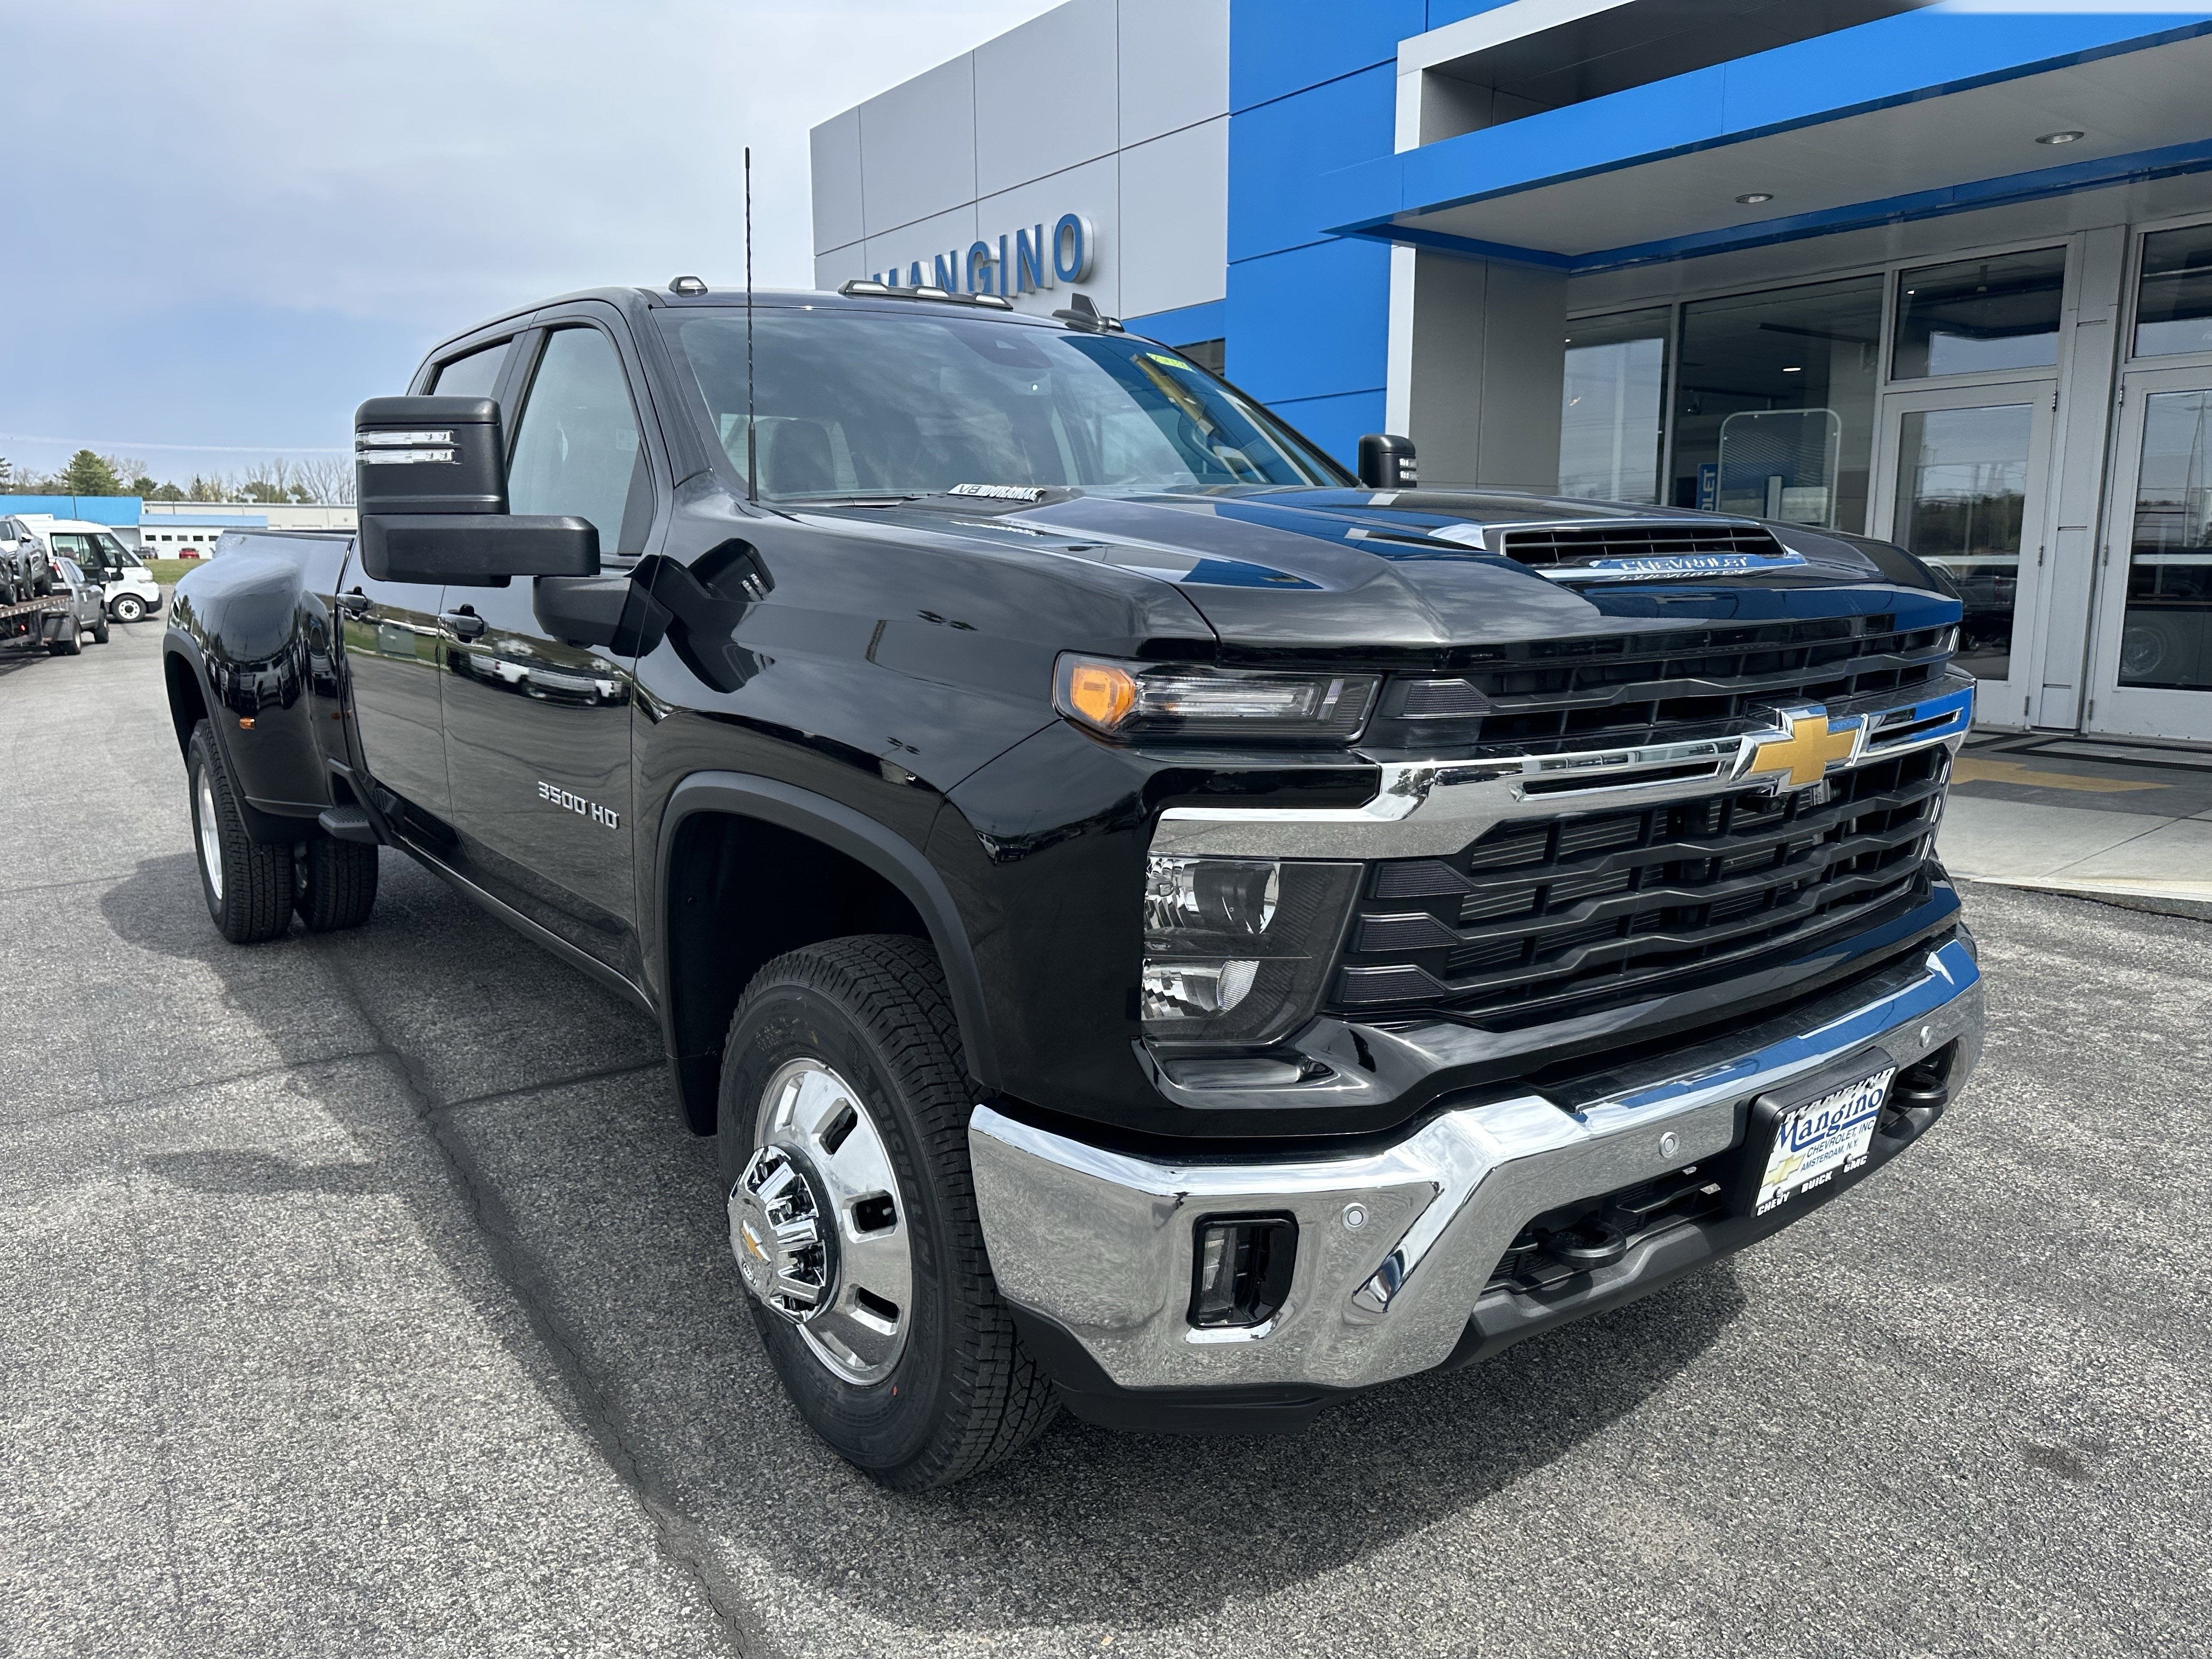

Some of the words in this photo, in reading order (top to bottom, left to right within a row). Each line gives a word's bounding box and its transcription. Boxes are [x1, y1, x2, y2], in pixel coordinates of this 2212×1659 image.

[873, 213, 1094, 297] ANGINO
[958, 484, 983, 494] V8
[1620, 556, 1747, 571] CHEVROLET
[538, 781, 587, 815] 3500
[591, 803, 619, 830] HD
[1774, 1088, 1884, 1153] Mangino
[1807, 1126, 1857, 1158] CHEVROLET,
[1757, 1191, 1791, 1216] CHEVY
[1801, 1171, 1833, 1194] BUICK
[1843, 1155, 1868, 1173] GMC
